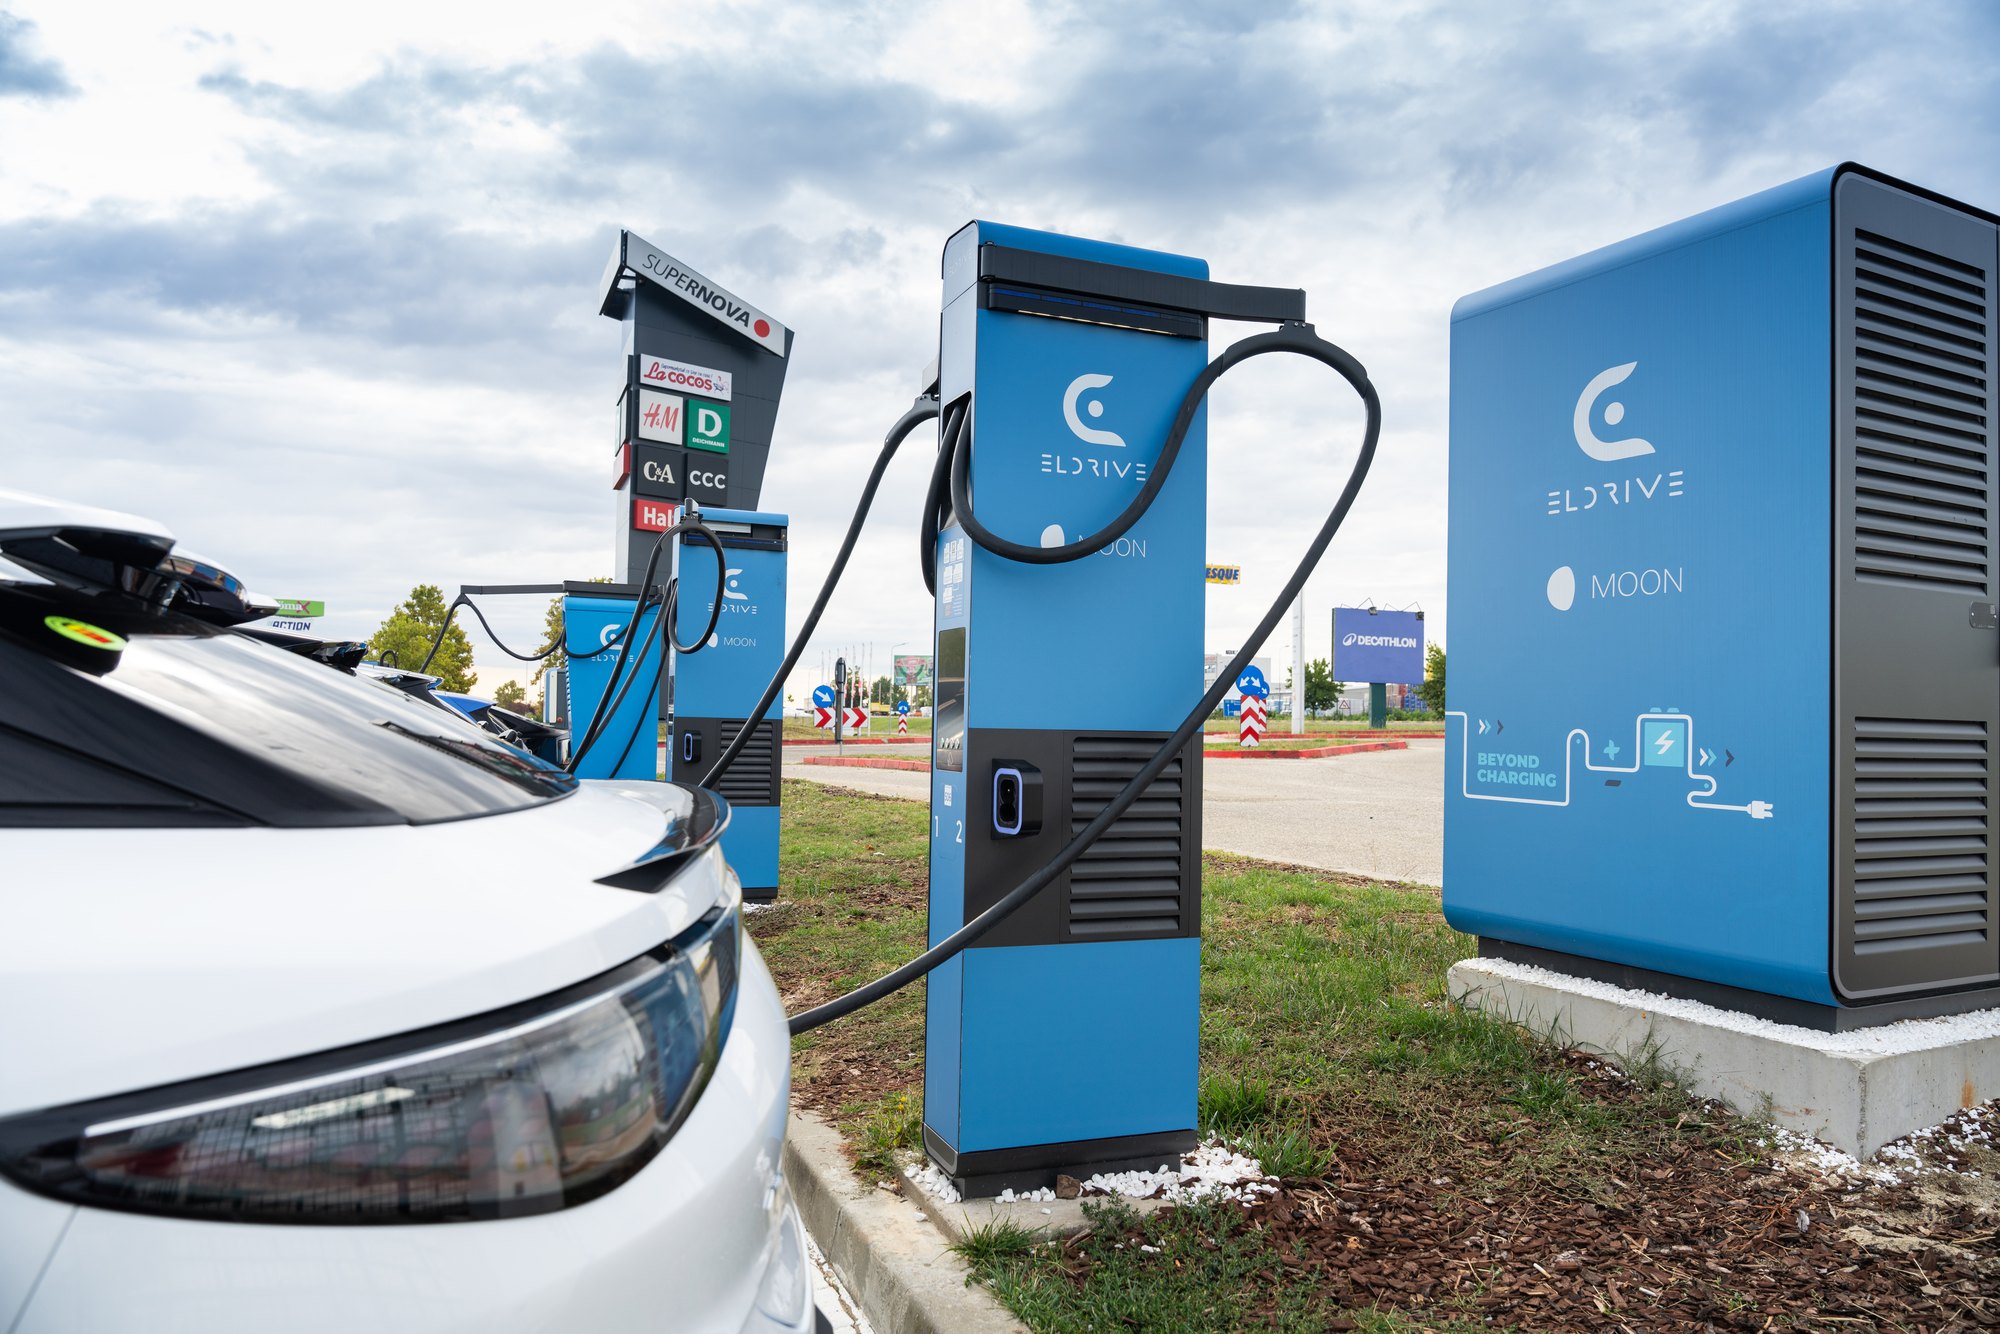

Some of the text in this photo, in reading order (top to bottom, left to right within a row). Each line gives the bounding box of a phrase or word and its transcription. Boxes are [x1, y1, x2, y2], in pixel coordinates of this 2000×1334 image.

[642, 254, 751, 328] SUPERNOVA
[643, 361, 667, 381] La
[643, 402, 680, 433] H&M
[698, 408, 723, 438] D
[692, 437, 726, 448] DEICHMANN
[643, 461, 676, 484] C&A
[1041, 453, 1147, 482] ELDRIVE
[689, 470, 727, 490] CCC
[1547, 470, 1684, 516] ELDRIVE
[643, 506, 674, 528] Hal
[1079, 535, 1147, 558] OON
[1591, 567, 1683, 599] MOON
[707, 602, 758, 615] EDRIVE
[272, 620, 311, 631] ACTION
[723, 637, 757, 648] MOON
[1357, 635, 1417, 648] DECATHLON
[591, 654, 634, 663] ELDRIE
[1477, 752, 1540, 769] BEYOND
[1477, 769, 1557, 787] CHARGING
[934, 815, 963, 844] 1 2
